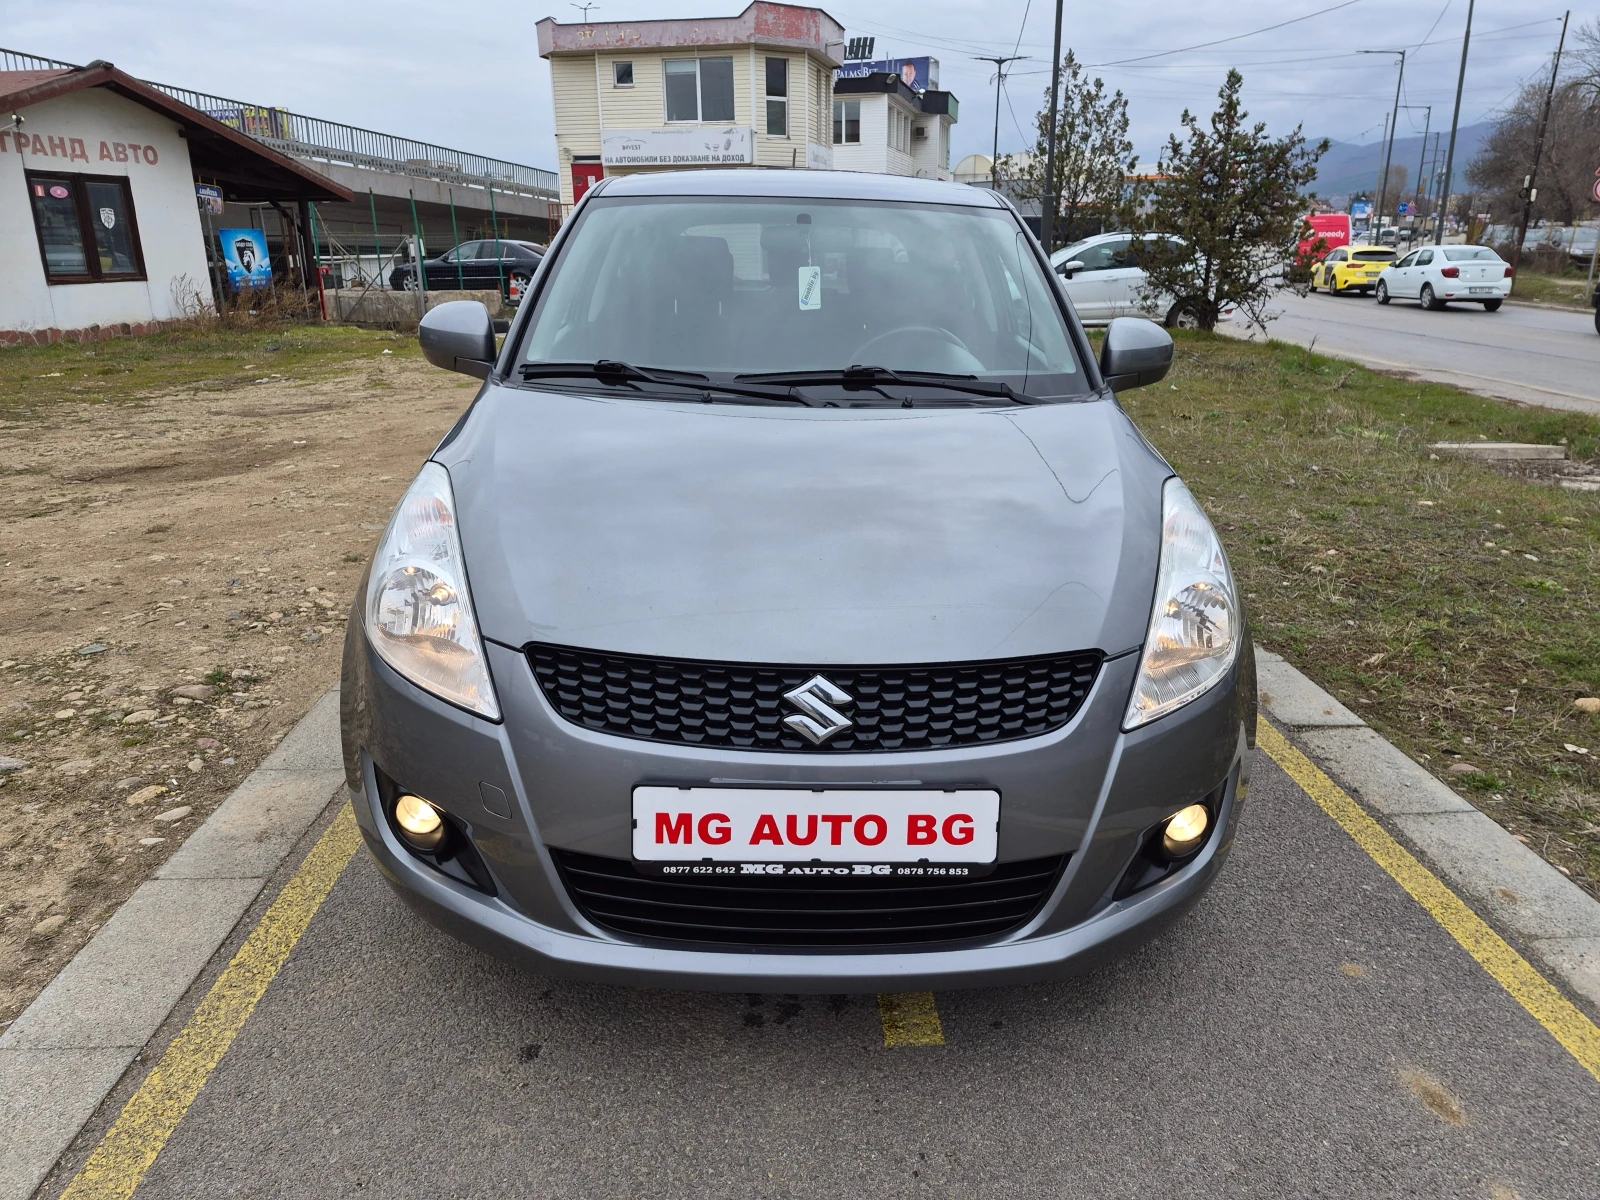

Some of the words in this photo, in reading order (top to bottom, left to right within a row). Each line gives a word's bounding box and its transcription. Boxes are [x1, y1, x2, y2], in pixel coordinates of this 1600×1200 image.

[0, 130, 90, 164] ГРАНД
[98, 140, 159, 165] АВТО
[659, 155, 671, 163] БЕЗ
[672, 154, 710, 163] ДОКАЗВАНЕ
[711, 154, 721, 162] НА
[722, 153, 745, 162] ДОХОД
[1318, 229, 1345, 238] speedy
[655, 812, 732, 845] MG
[748, 814, 887, 846] AUTO
[906, 813, 975, 845] BG
[662, 866, 690, 874] 0877
[692, 866, 713, 874] 622
[715, 866, 736, 874] 642
[740, 863, 786, 875] MG
[787, 867, 850, 875] AUTO
[851, 864, 893, 875] BG
